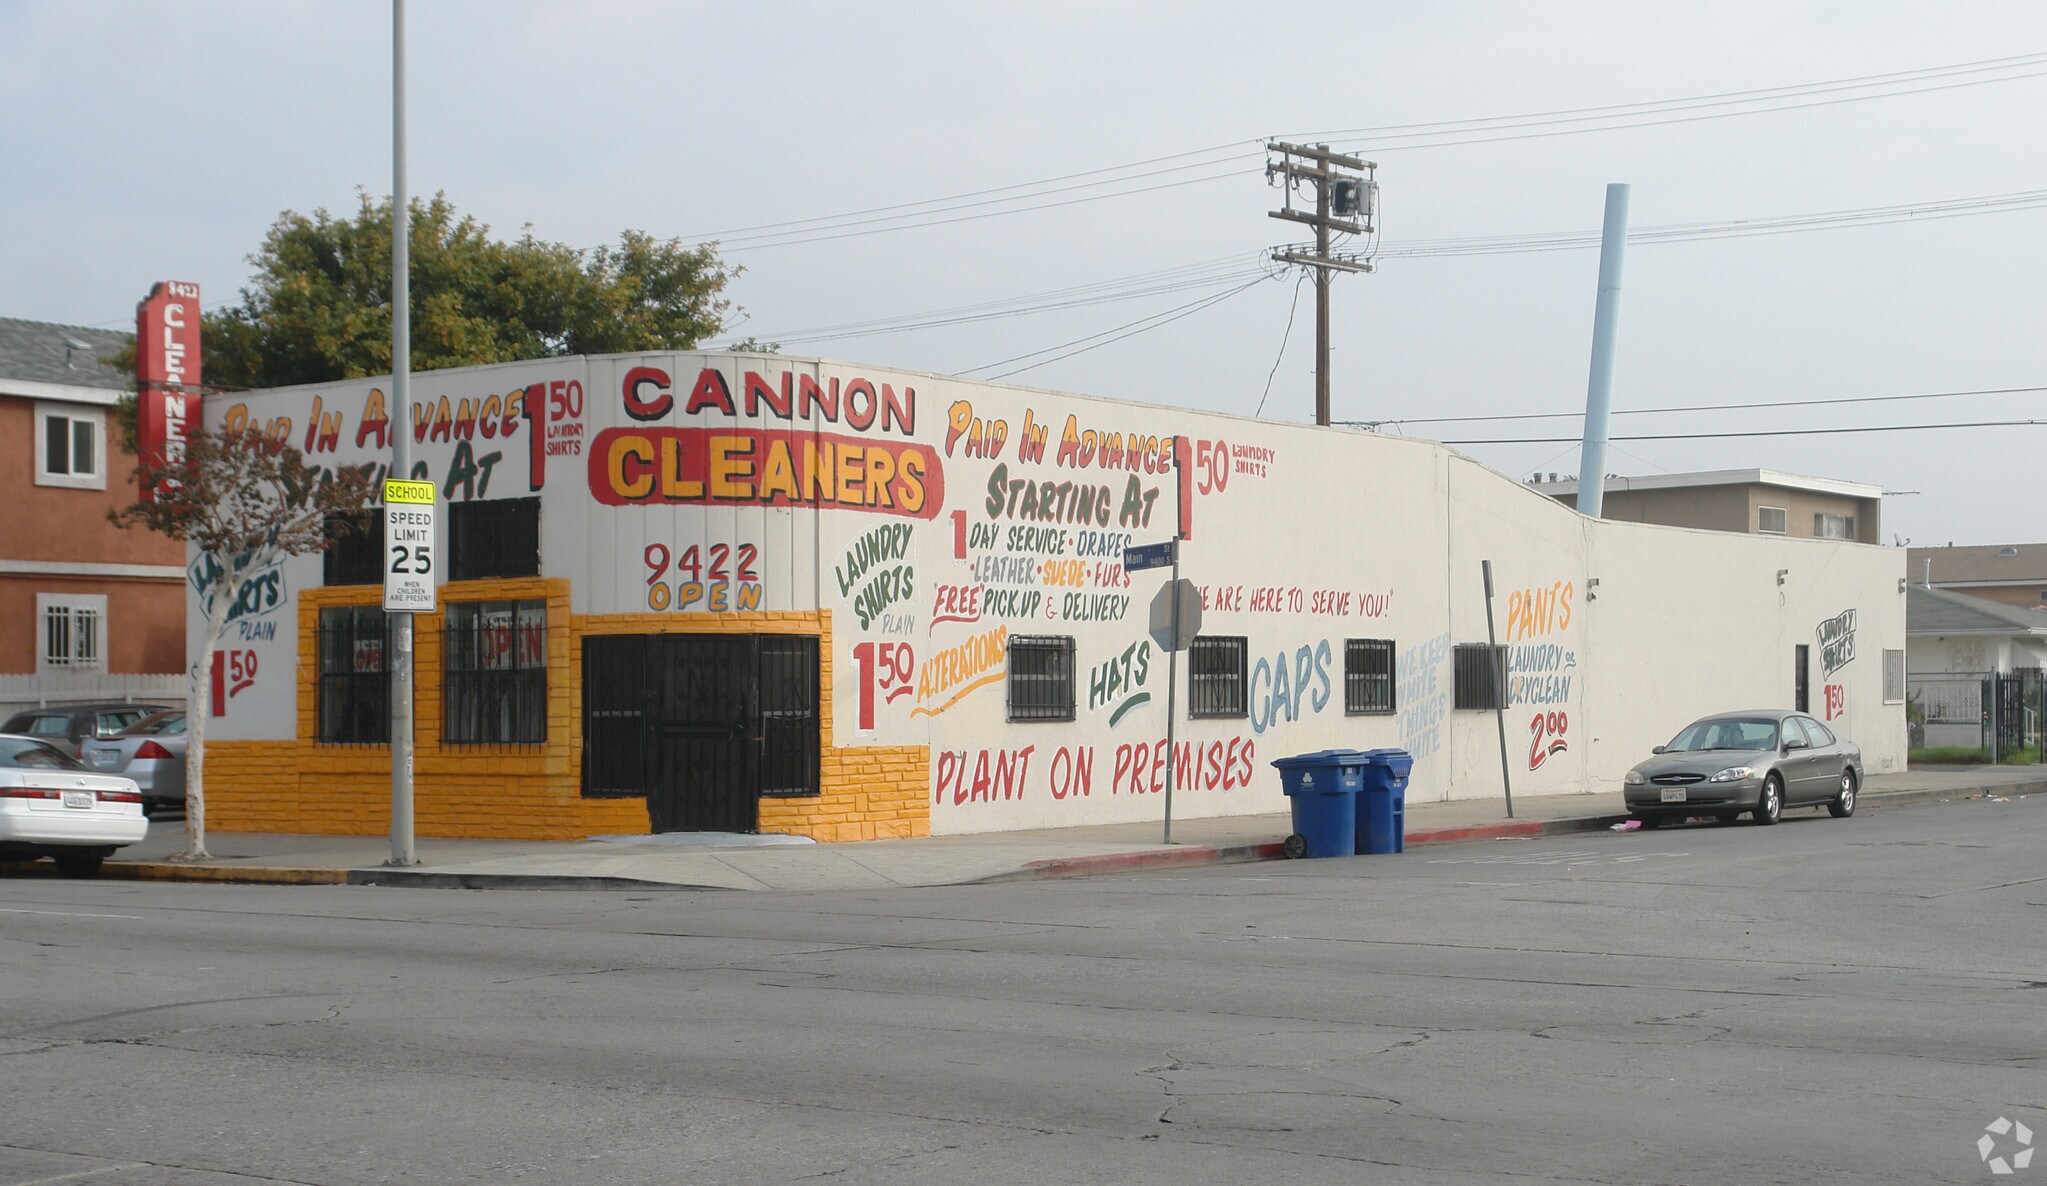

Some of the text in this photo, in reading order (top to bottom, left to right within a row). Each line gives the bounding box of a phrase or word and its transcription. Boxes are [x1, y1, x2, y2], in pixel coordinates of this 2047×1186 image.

[622, 366, 915, 436] CANNON
[304, 395, 343, 453] IN
[945, 400, 1173, 474] PAID IN ADVANCE
[546, 440, 581, 456] SHIRTS
[443, 440, 502, 500] AT
[608, 435, 926, 512] CLEANERS
[1235, 460, 1267, 478] SHIRTS
[388, 486, 432, 500] SCHOOL
[985, 462, 1159, 529] STARTING AT
[390, 512, 431, 525] SPEED
[394, 529, 427, 541] LIMIT
[950, 510, 967, 559] 1
[969, 522, 1000, 550] DAY
[1007, 525, 1067, 555] SERVICE
[391, 545, 431, 574] 25
[644, 542, 759, 585] 9422
[835, 522, 913, 598] LAUNDRY
[974, 555, 1035, 584] LEATHER
[1043, 559, 1086, 588] SUEDE
[1126, 553, 1143, 565] Main
[389, 594, 431, 602] ARE PRESENT
[648, 581, 762, 611] OPEN
[854, 565, 914, 631] SHIRTS
[1045, 596, 1058, 619] &
[1063, 591, 1130, 621] DELIVERY
[1215, 585, 1243, 612] ARE
[1250, 587, 1284, 613] HERE
[1288, 586, 1303, 613] TO
[1312, 589, 1350, 616] SERVE
[1506, 580, 1574, 641] PANTS
[239, 620, 279, 641] PLAIN
[882, 613, 915, 635] PLAIN
[917, 624, 1007, 703] ALTERATIONS
[1089, 640, 1150, 710] HATS
[1507, 644, 1563, 672] LAUNDRY
[1251, 639, 1331, 733] CAPS
[936, 736, 1255, 806] PLANT ON PREMISES
